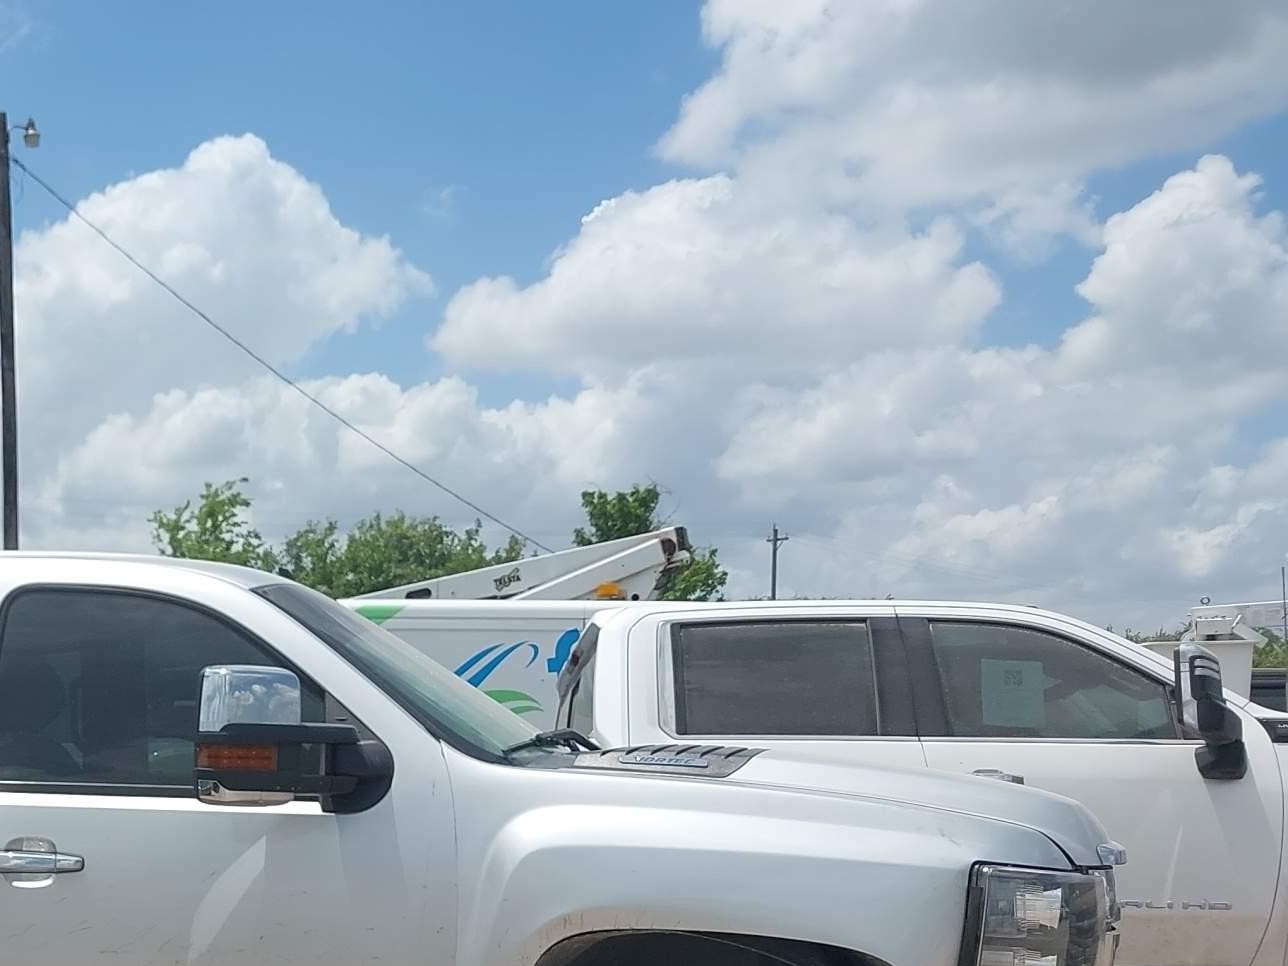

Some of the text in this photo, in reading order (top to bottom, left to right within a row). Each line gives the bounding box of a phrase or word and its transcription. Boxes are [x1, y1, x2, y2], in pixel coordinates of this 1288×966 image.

[634, 755, 695, 764] VORTEC
[1120, 899, 1232, 911] ALI HD
